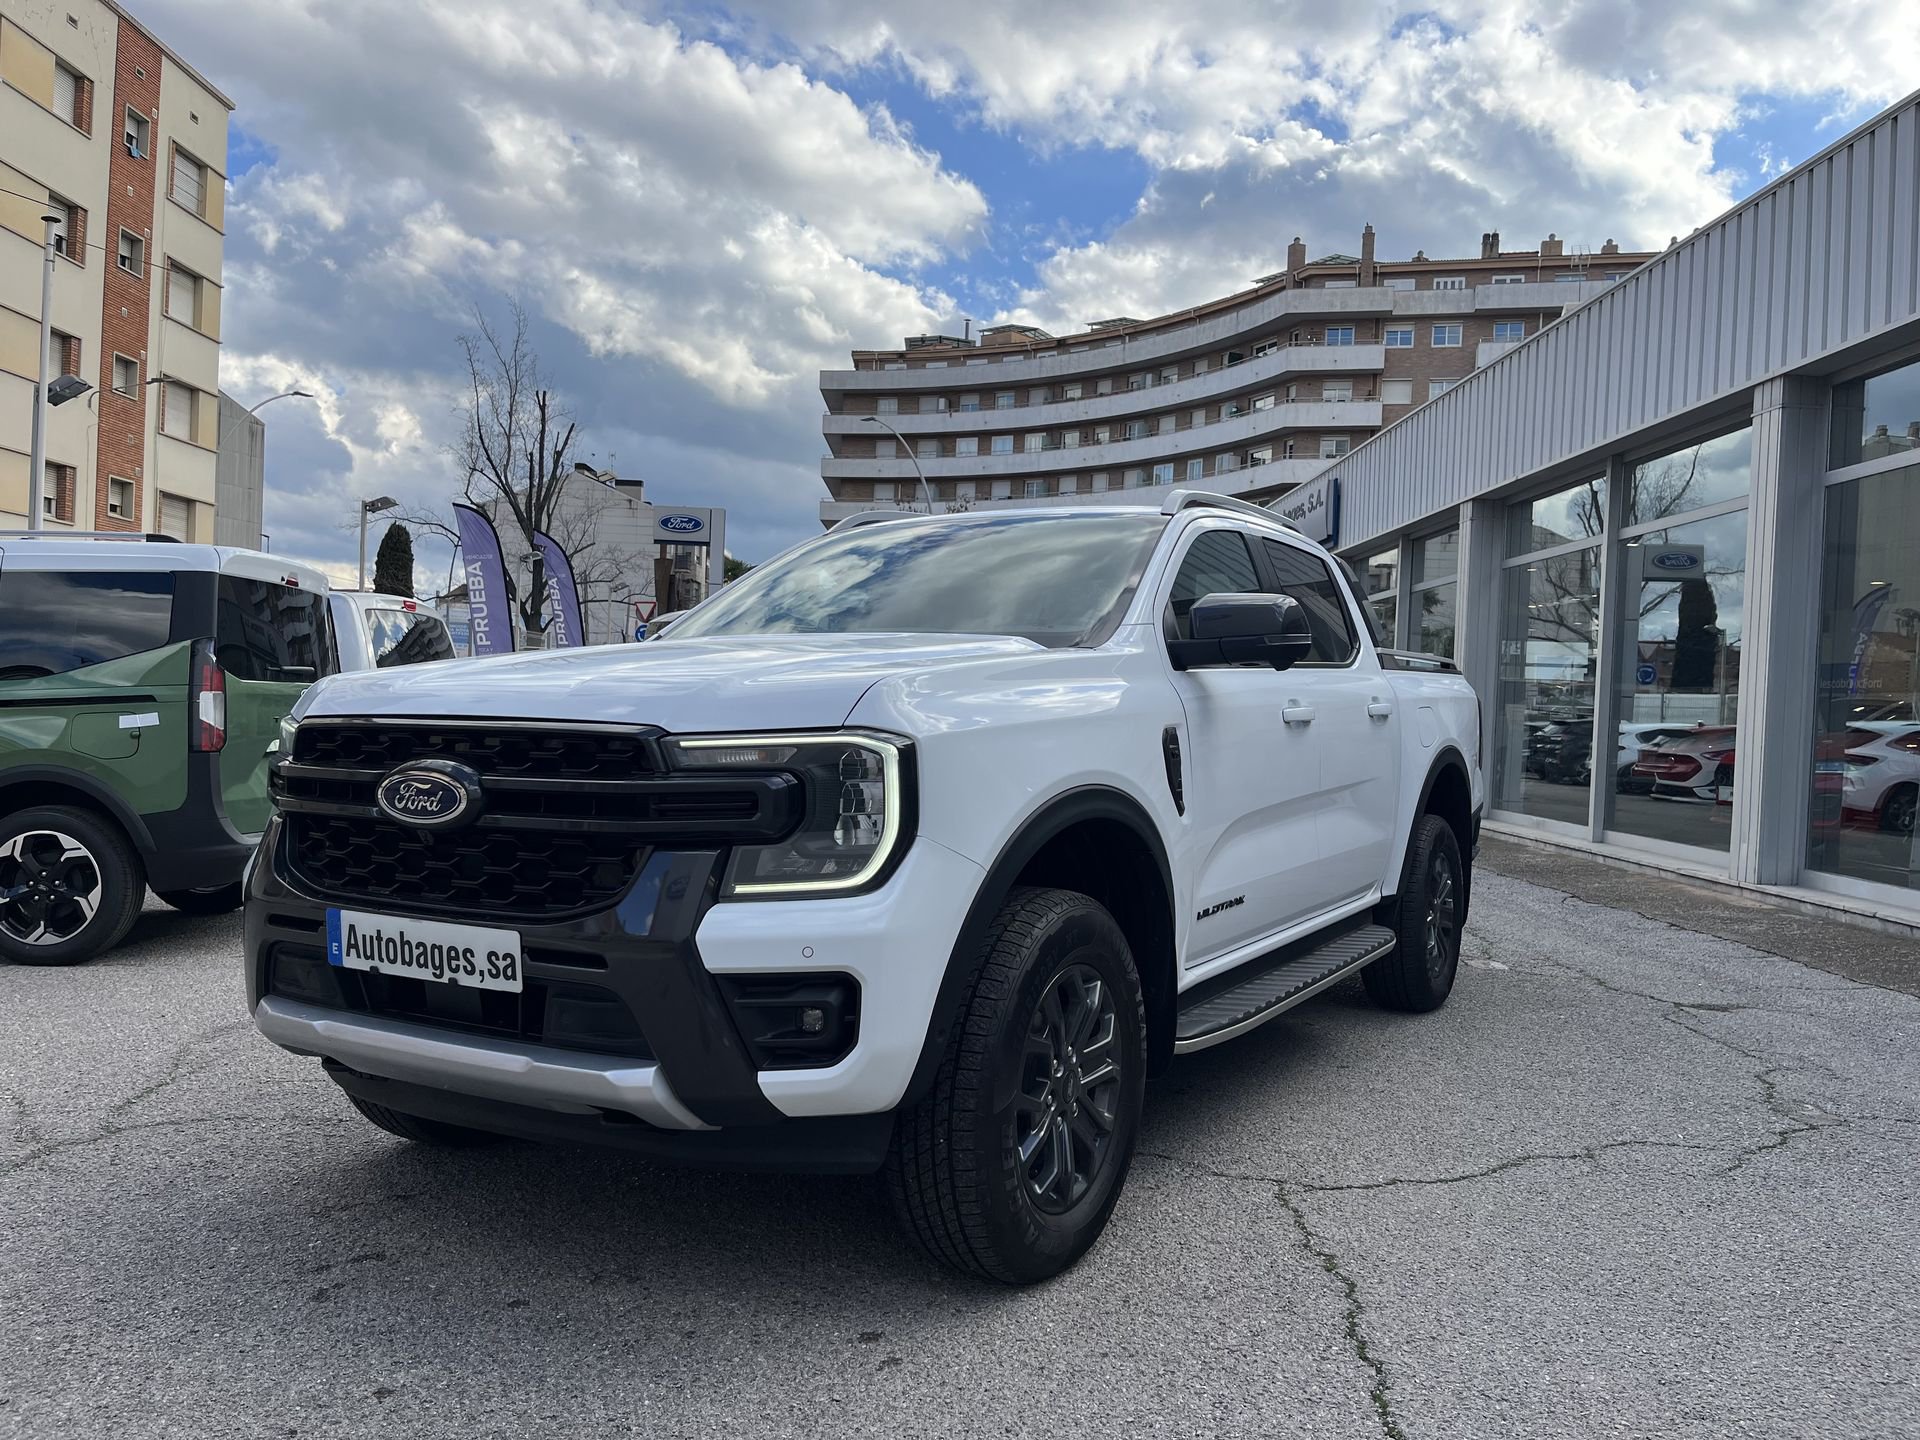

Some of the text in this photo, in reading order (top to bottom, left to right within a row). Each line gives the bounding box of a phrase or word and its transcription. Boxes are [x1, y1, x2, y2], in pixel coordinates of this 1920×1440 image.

[667, 517, 695, 530] Ford
[466, 561, 492, 646] PRUEBA
[547, 577, 569, 645] PRUEBA
[394, 781, 443, 812] Ford
[332, 943, 339, 954] E
[345, 923, 518, 983] Autobages,sa
